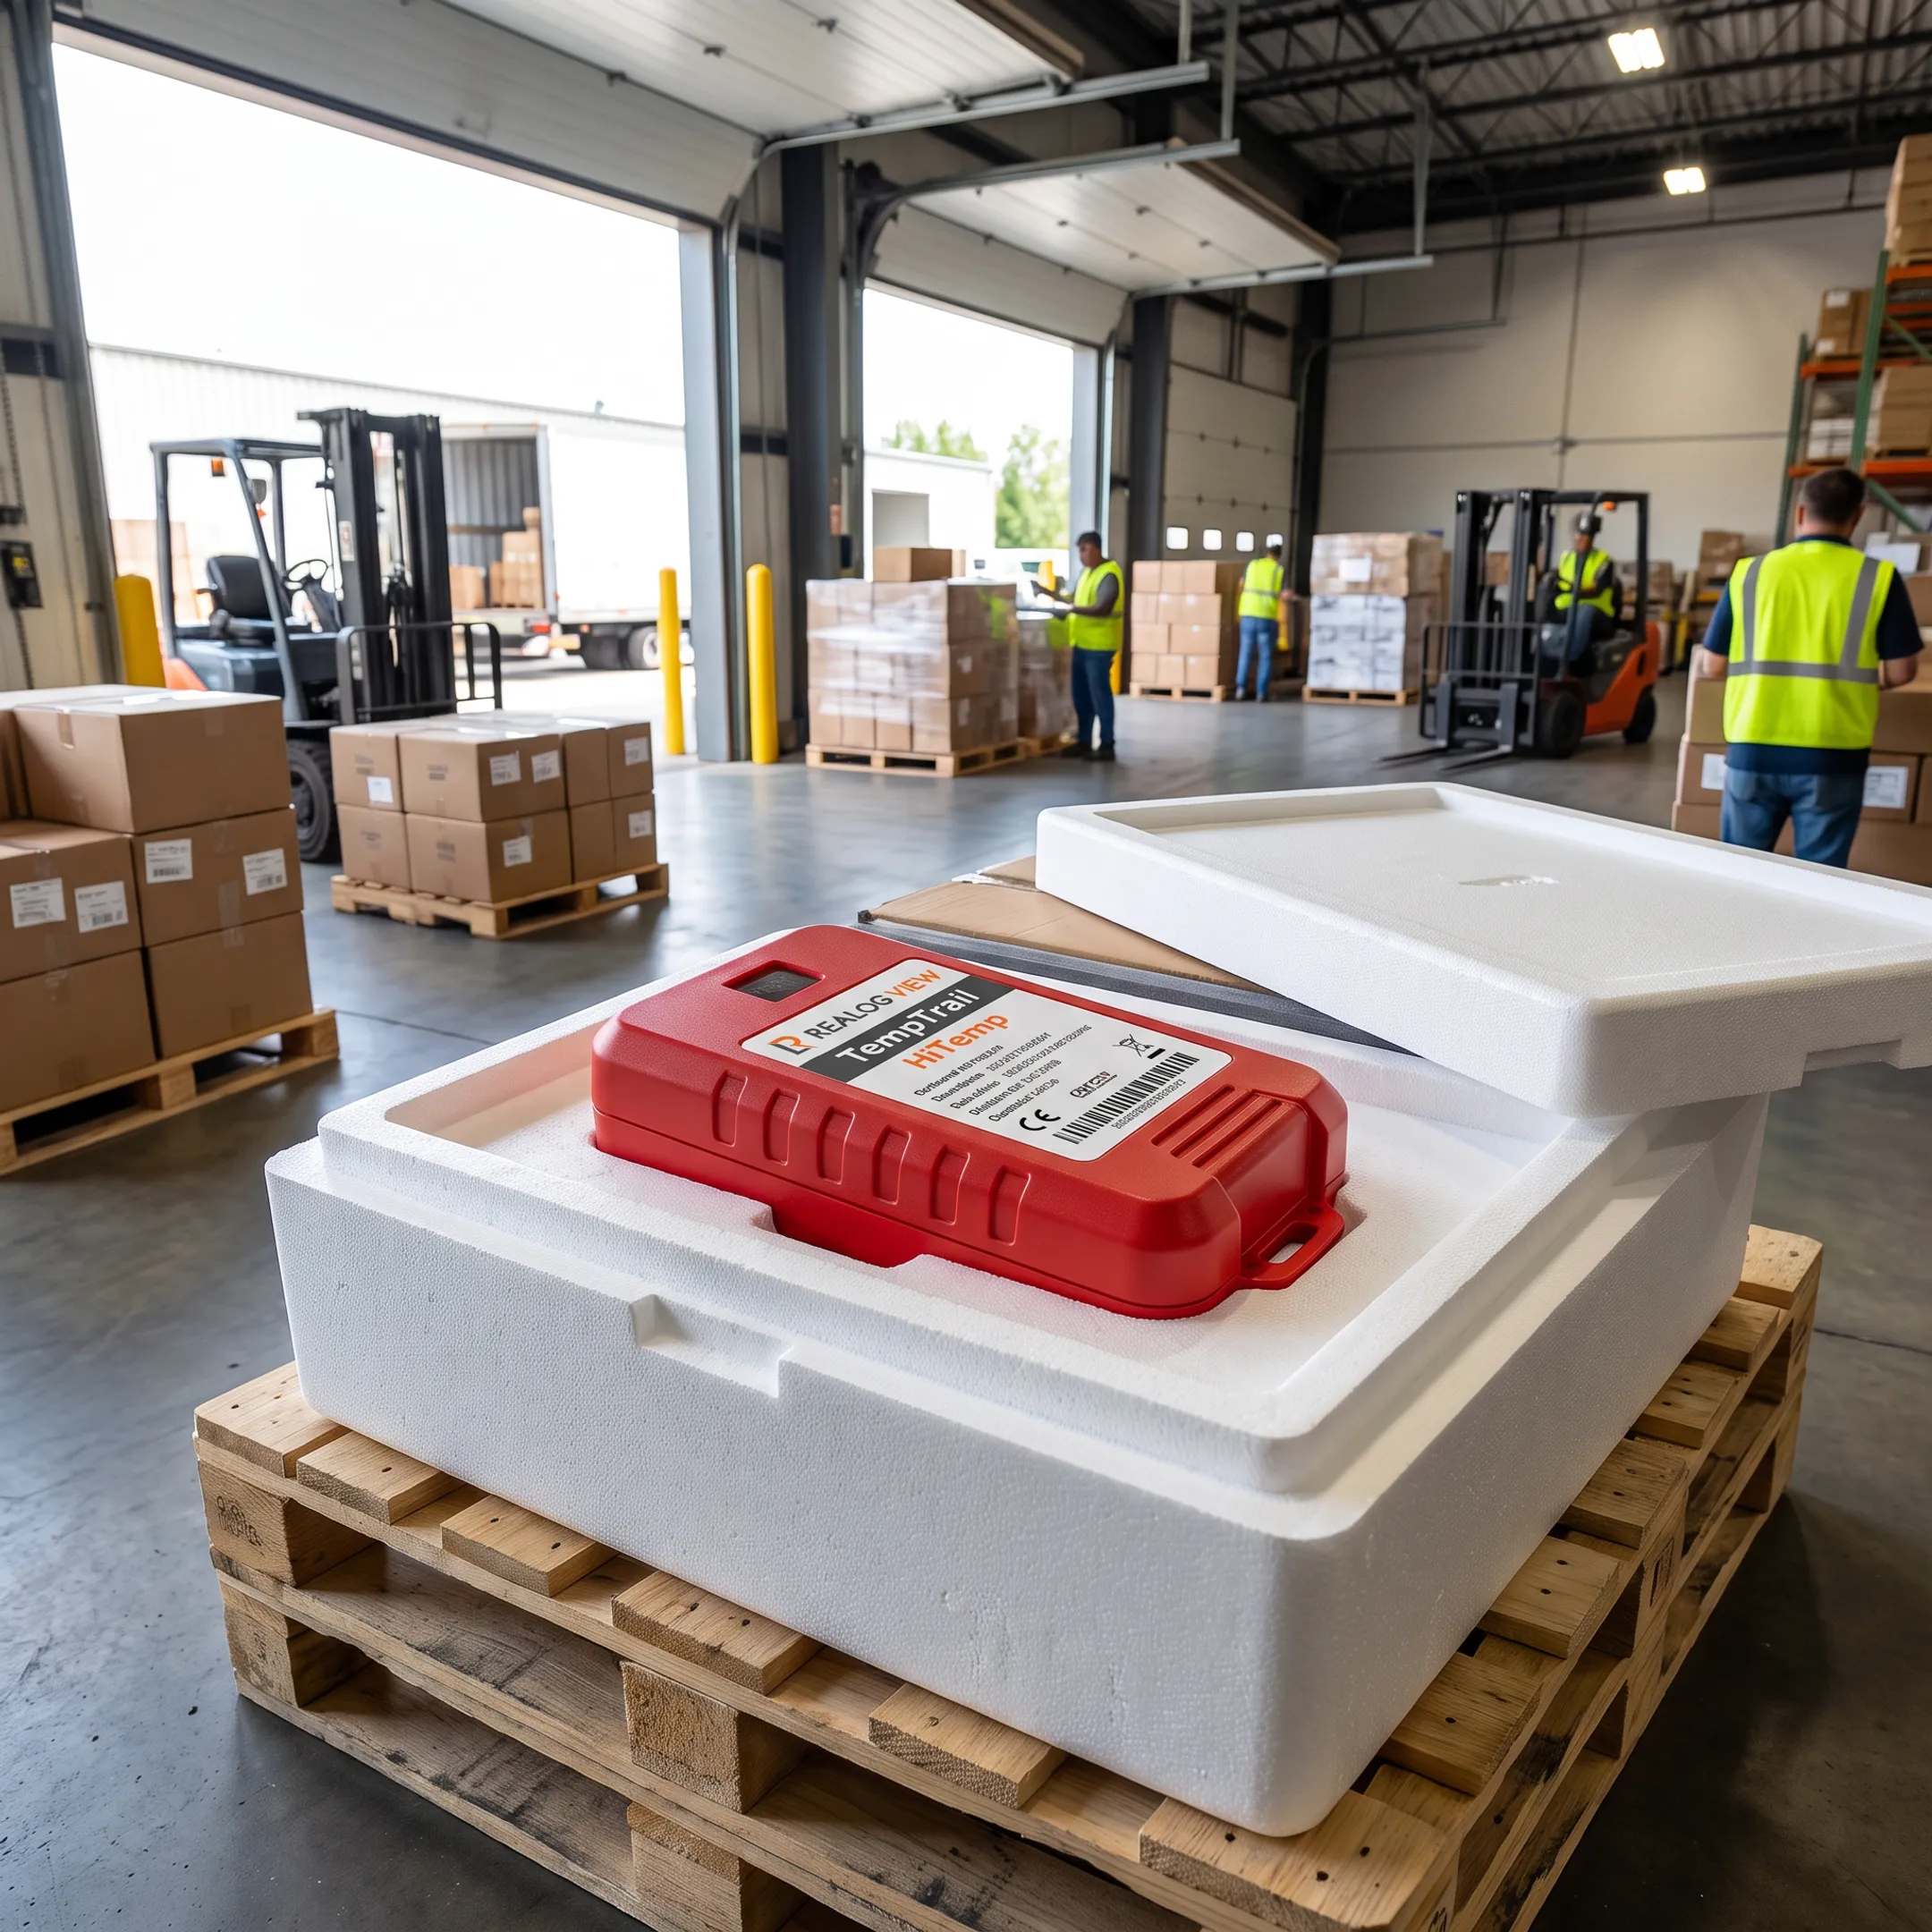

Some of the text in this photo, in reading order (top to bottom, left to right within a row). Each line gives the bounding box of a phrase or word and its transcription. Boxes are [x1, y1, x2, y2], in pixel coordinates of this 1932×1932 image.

[802, 995, 894, 1039] REALOG
[884, 970, 941, 997] VIEW
[835, 988, 980, 1062] TempTrail
[902, 1015, 1009, 1070] HiTemp
